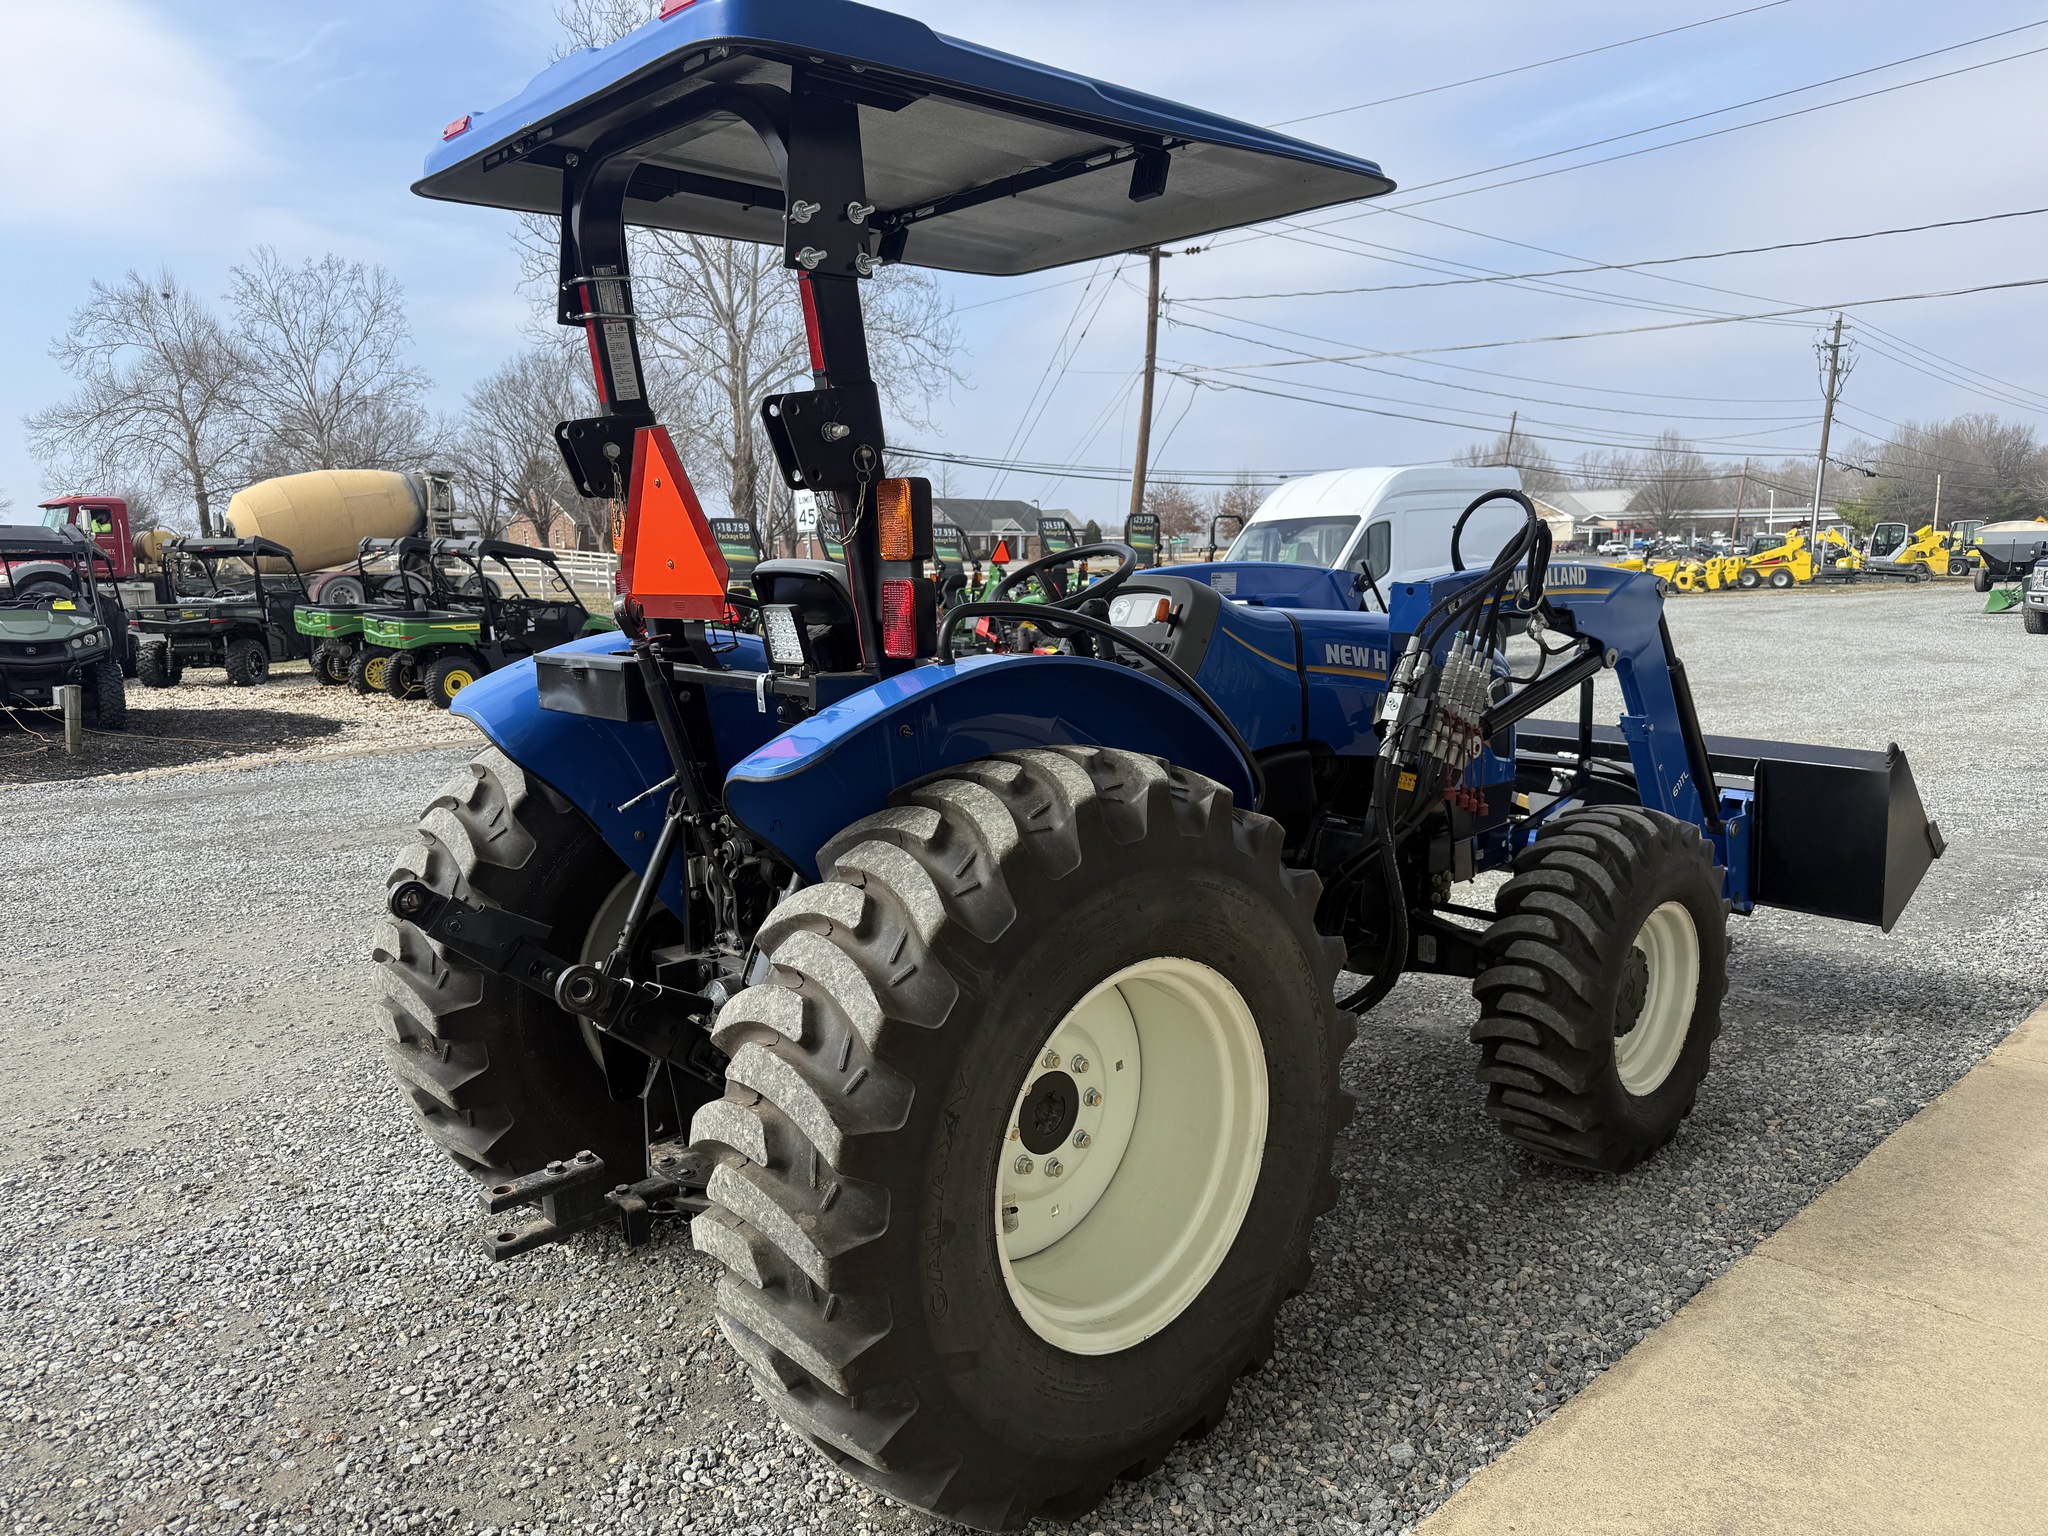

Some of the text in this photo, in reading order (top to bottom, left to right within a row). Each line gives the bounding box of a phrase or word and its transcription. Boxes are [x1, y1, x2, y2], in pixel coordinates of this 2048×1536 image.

[799, 496, 813, 504] LIMIT
[799, 508, 816, 525] 45
[716, 522, 750, 532] $18,799
[934, 528, 957, 537] 27,999
[718, 533, 739, 541] Package
[1505, 570, 1526, 591] EW
[1325, 643, 1369, 667] NEW
[1188, 878, 1252, 907] TUBELESS
[925, 1072, 969, 1320] GALAXY
